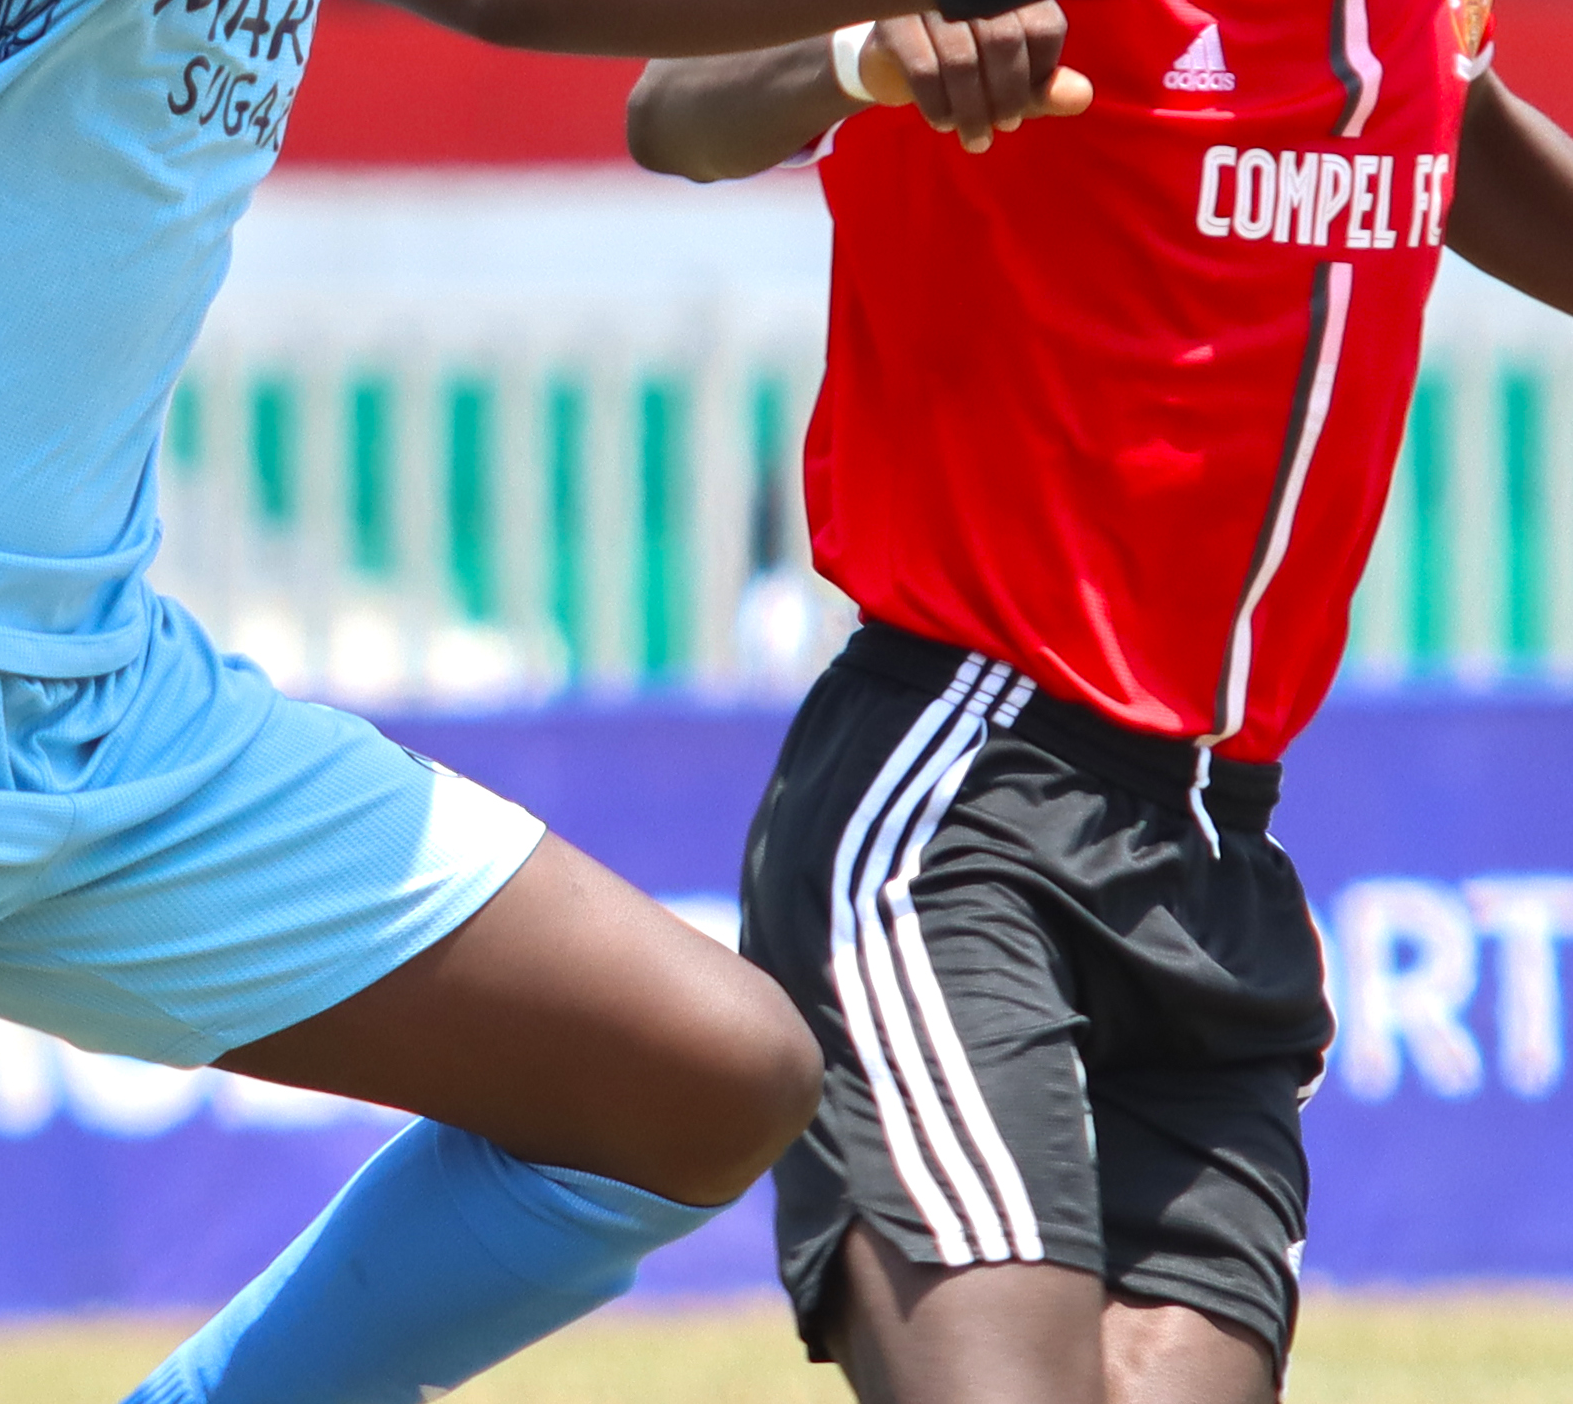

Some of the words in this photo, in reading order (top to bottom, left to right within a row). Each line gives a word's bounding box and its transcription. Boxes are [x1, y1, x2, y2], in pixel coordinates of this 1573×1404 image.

[1163, 70, 1236, 92] adidas
[1196, 145, 1398, 249] COMPEL
[1407, 153, 1450, 248] FC
